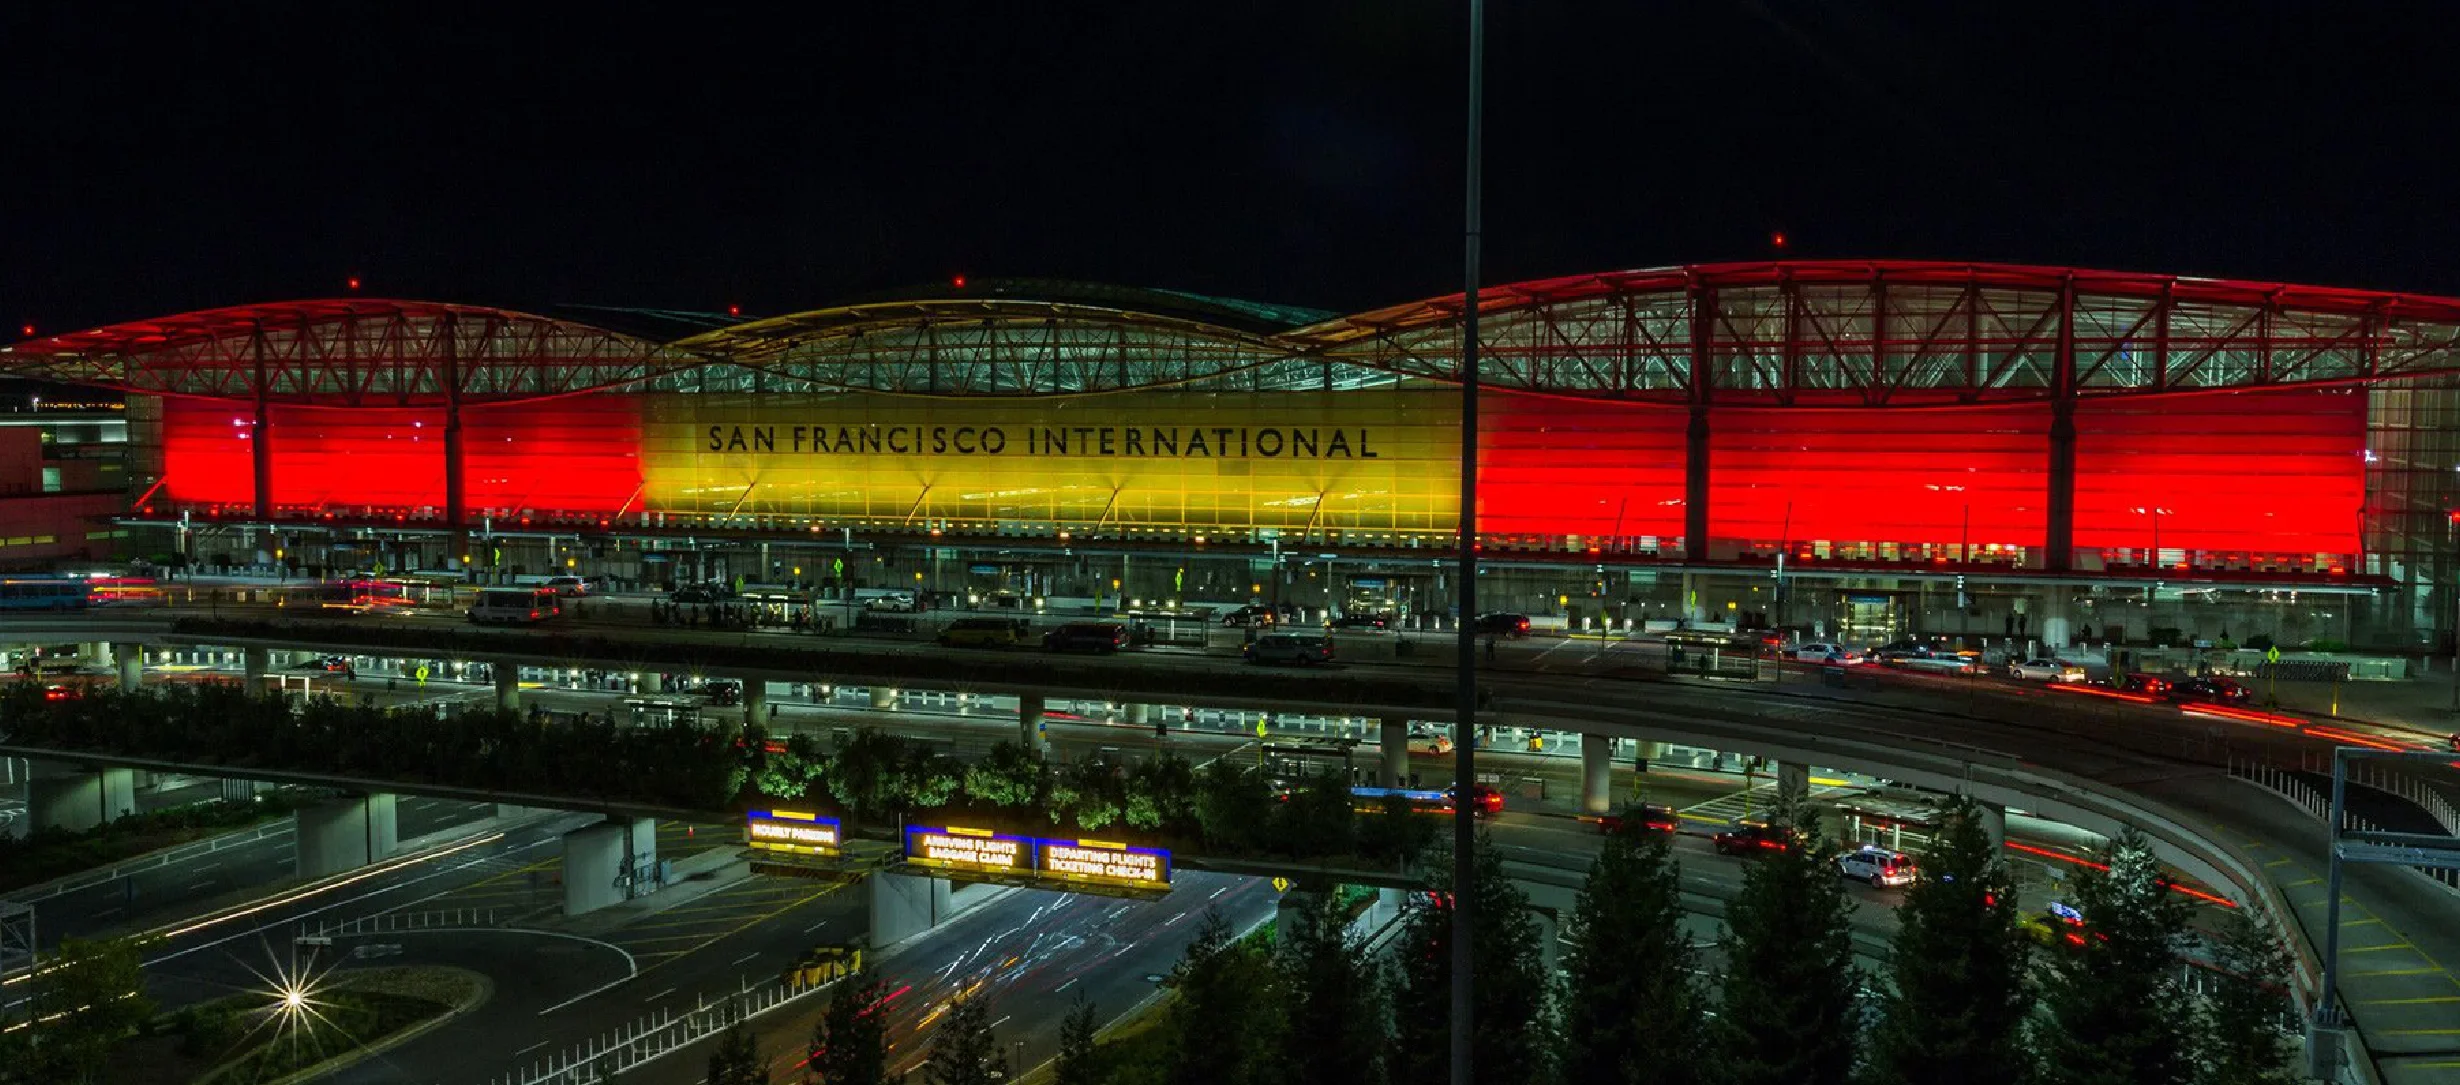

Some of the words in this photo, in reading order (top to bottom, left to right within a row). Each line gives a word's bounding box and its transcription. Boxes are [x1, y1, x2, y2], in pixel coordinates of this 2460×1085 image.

[708, 426, 774, 451] SAN
[793, 426, 1006, 453] FRANCISCO
[1028, 427, 1378, 458] INTERNATIONAL
[924, 834, 974, 850] ARRIVING
[975, 839, 1017, 854] FLIGHTS
[928, 846, 977, 863] BAGGAGE
[978, 852, 1013, 866] CLAIM
[1049, 846, 1109, 863] DEPARTING
[1110, 853, 1156, 868] FLIGHTS
[1050, 858, 1104, 875] TICKETING
[1105, 865, 1156, 881] CHECK-IN
